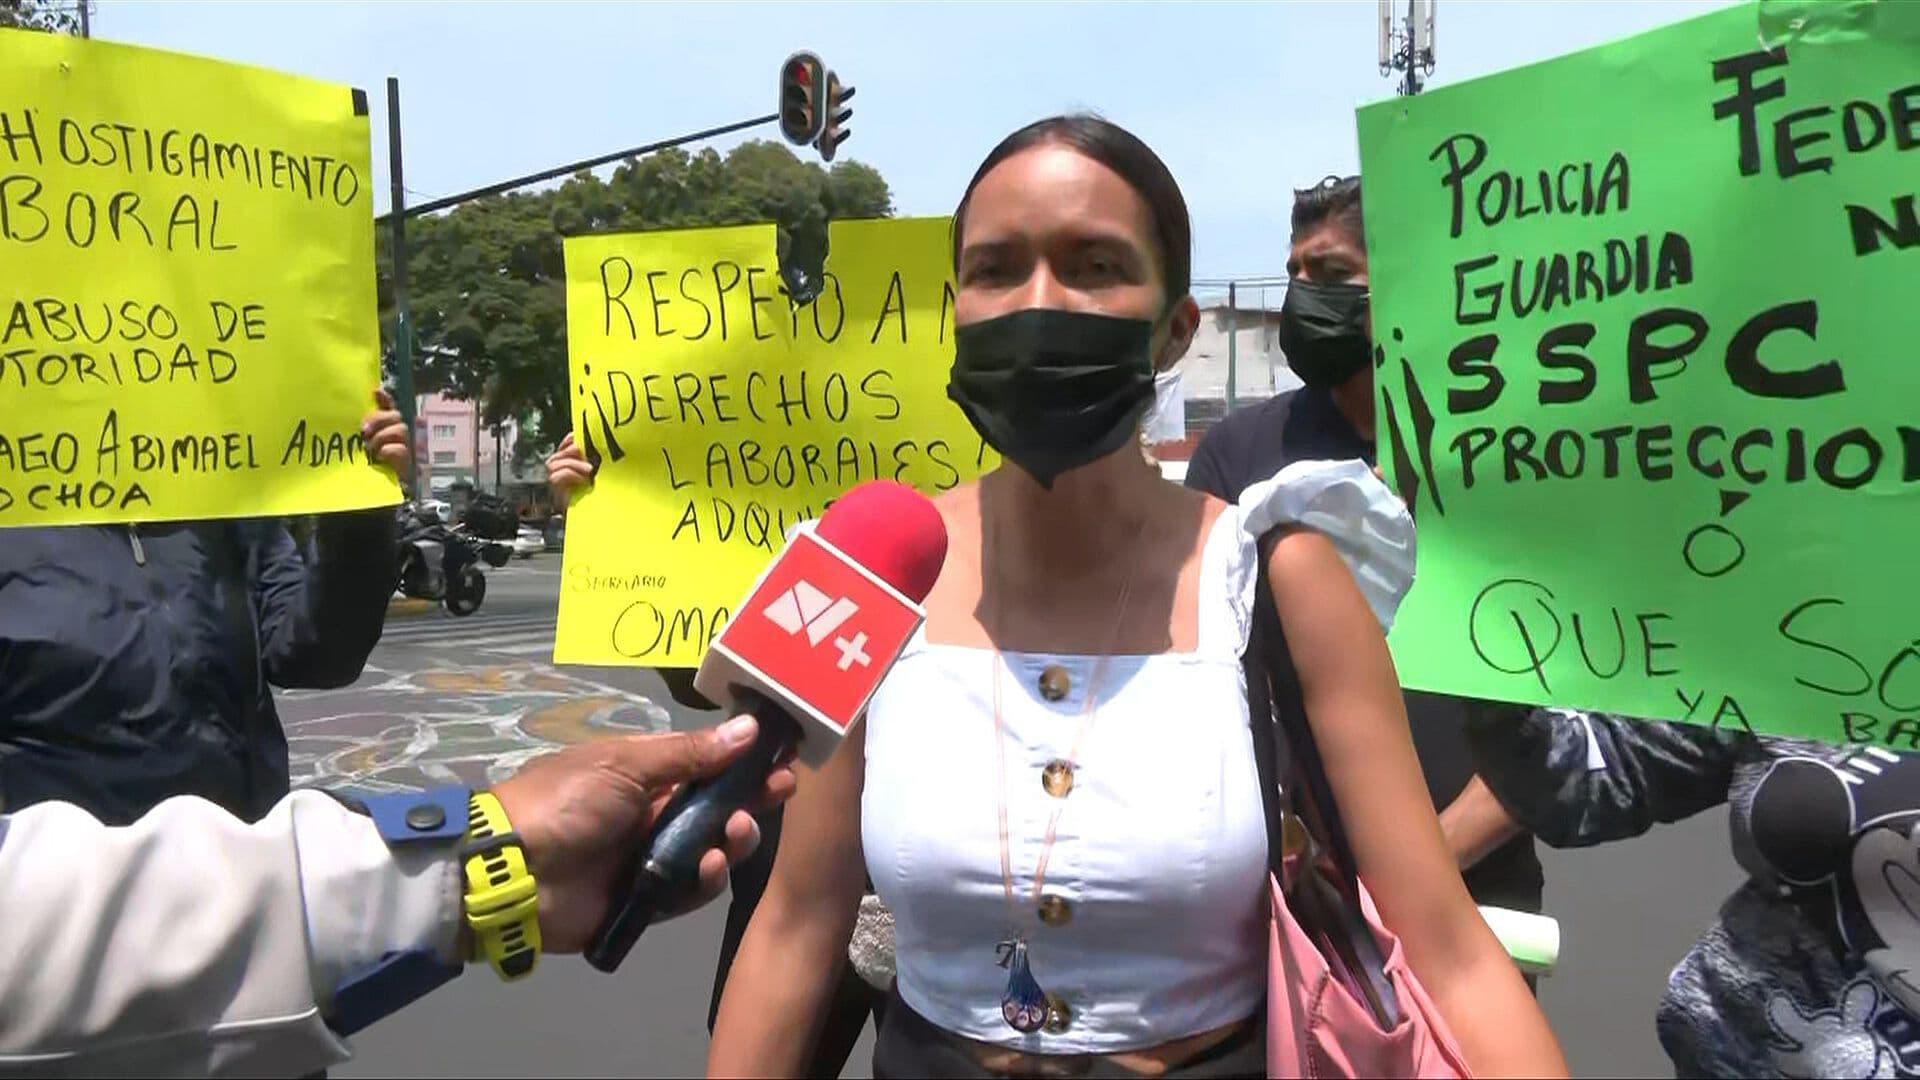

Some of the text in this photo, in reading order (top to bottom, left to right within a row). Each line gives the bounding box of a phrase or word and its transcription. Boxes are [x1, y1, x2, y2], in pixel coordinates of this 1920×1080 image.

[2, 108, 359, 206] HOSTIGAMIENTO
[1429, 133, 1630, 238] POLICIA
[869, 270, 907, 344] A
[1454, 231, 1693, 326] GUARDIA
[2, 300, 267, 343] ABUSO DE
[1447, 300, 1847, 415] SSPC
[0, 343, 238, 387] TORIDAD
[97, 408, 260, 477] ABIMAEL
[1469, 578, 1681, 694] QUE
[1676, 688, 1758, 741] YA
